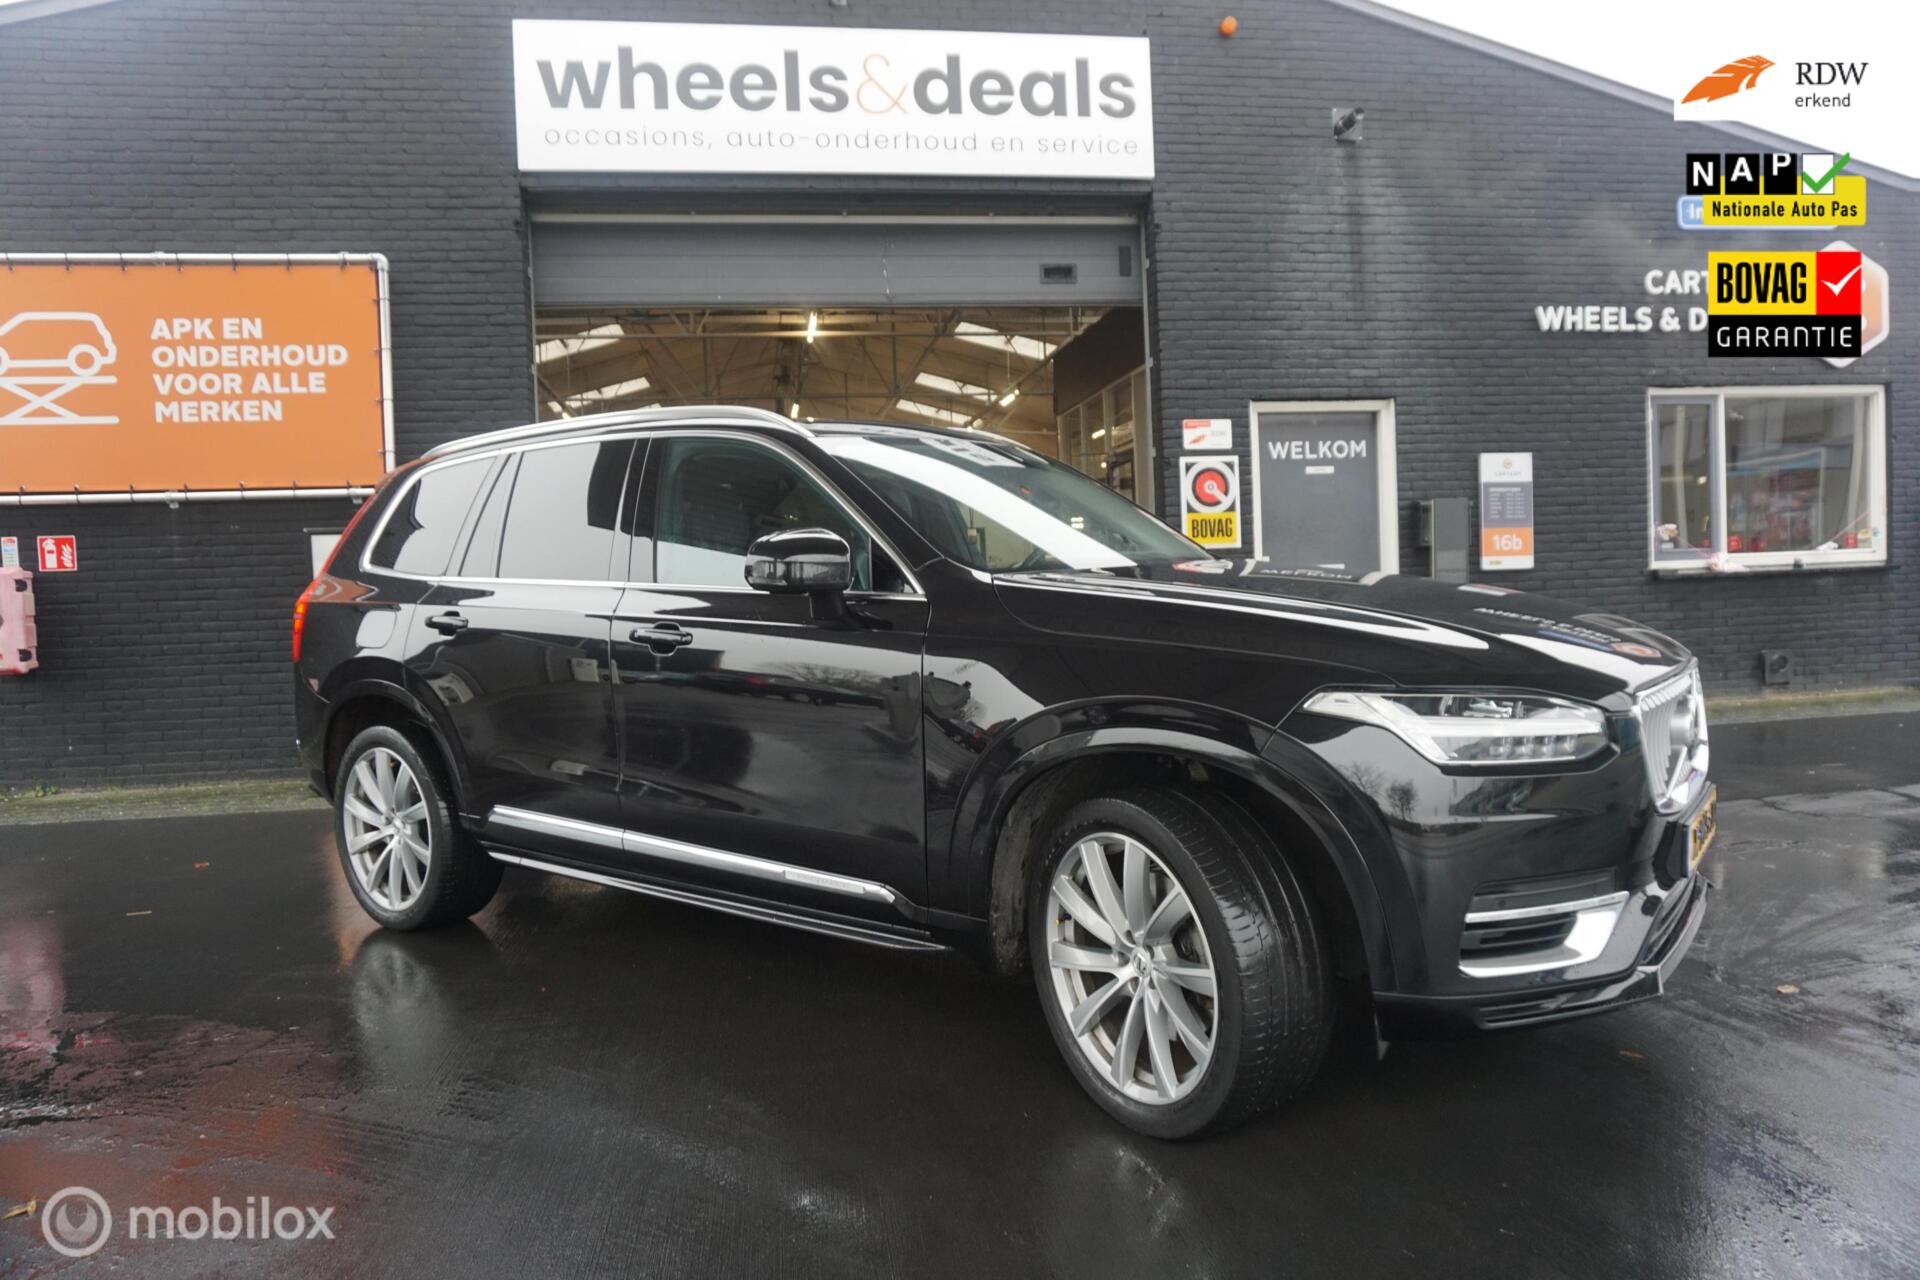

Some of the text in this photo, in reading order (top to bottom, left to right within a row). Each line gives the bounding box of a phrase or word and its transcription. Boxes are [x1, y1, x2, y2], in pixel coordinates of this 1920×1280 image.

[536, 45, 1136, 119] wheels&deals
[543, 127, 1138, 155] occasions, auto-onderhoud en service
[150, 317, 263, 340] APK EN
[1535, 305, 1654, 332] WHEELS
[1659, 306, 1681, 332] &
[151, 344, 349, 368] ONDERHOUD
[152, 371, 327, 396] VOOR ALLE
[154, 399, 283, 424] MERKEN
[1267, 439, 1368, 460] WELKOM
[1191, 518, 1233, 538] BOVAG
[1492, 534, 1524, 551] 16b
